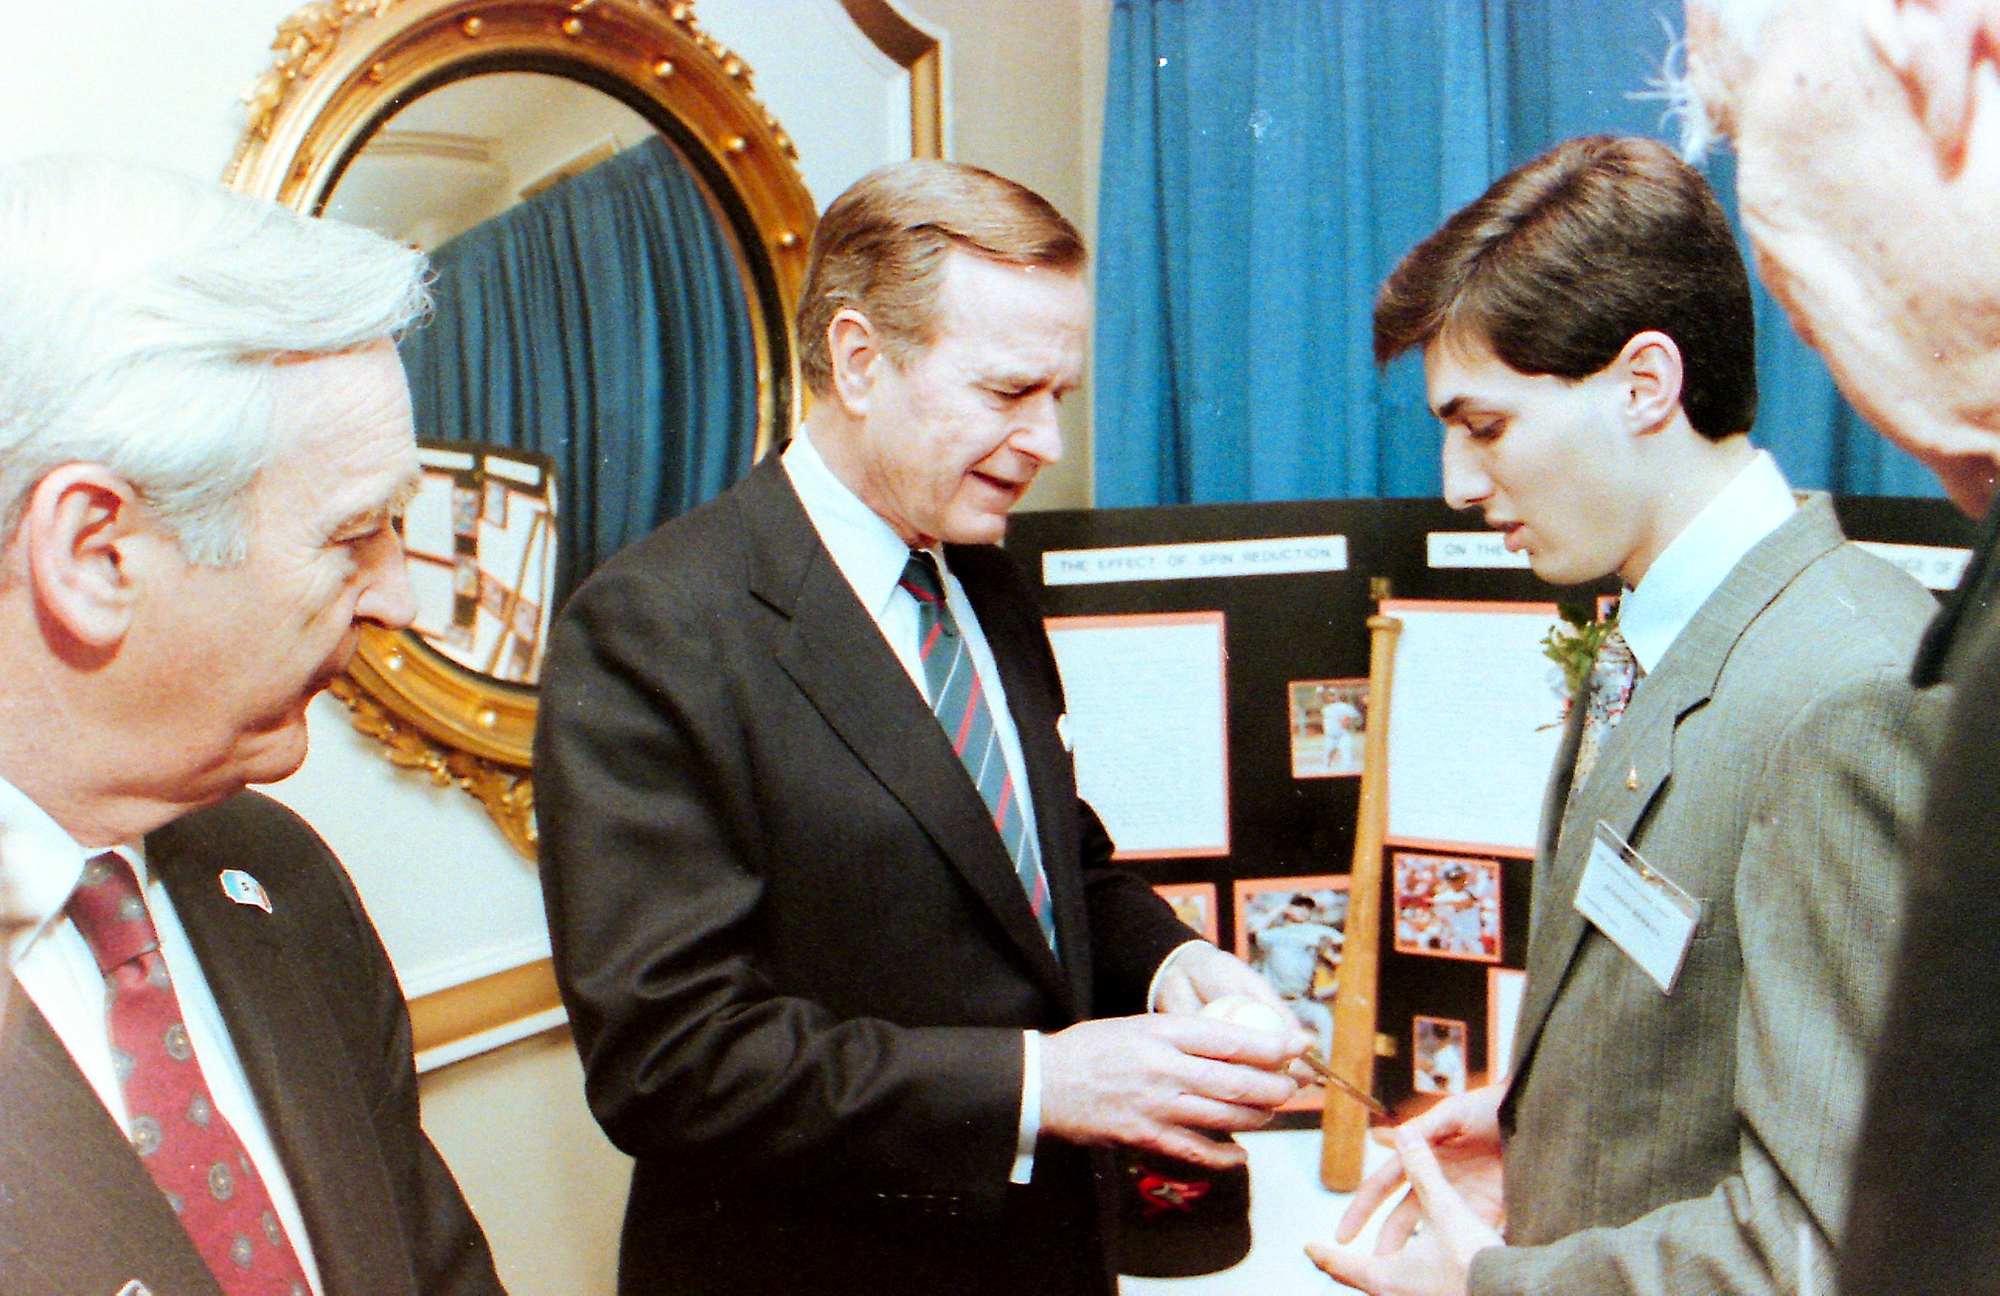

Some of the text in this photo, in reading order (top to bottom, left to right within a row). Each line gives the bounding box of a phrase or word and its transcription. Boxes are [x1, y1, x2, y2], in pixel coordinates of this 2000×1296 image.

[1059, 547, 1332, 572] THE EFFECT OF SPIN REDUCTION
